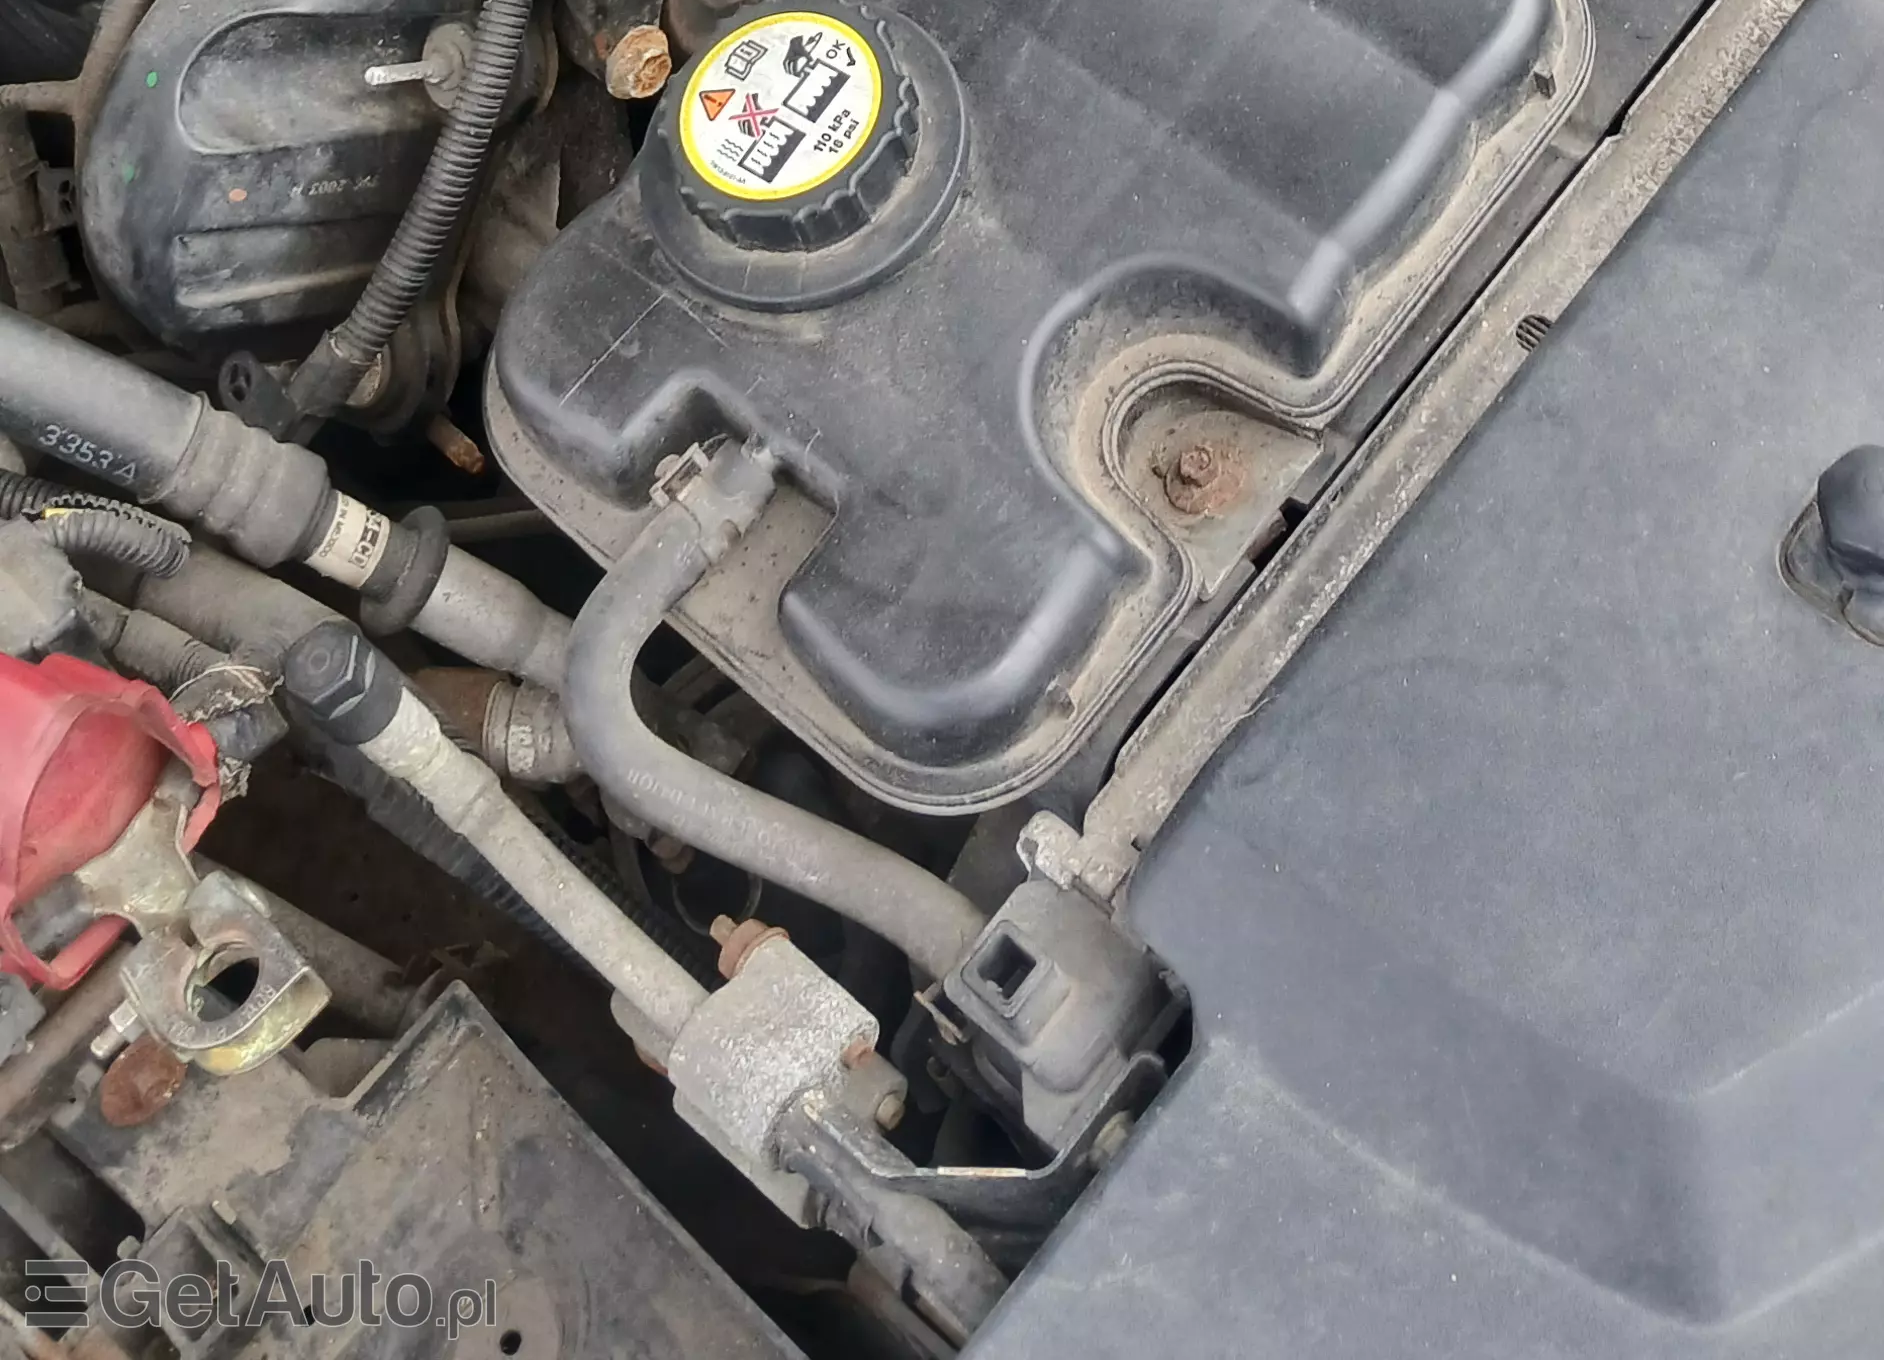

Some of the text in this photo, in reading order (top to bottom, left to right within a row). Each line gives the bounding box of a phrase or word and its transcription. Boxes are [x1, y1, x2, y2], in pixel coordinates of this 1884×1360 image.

[826, 40, 846, 60] OK
[813, 109, 851, 153] 110 kPa
[828, 118, 860, 155] 16 psi
